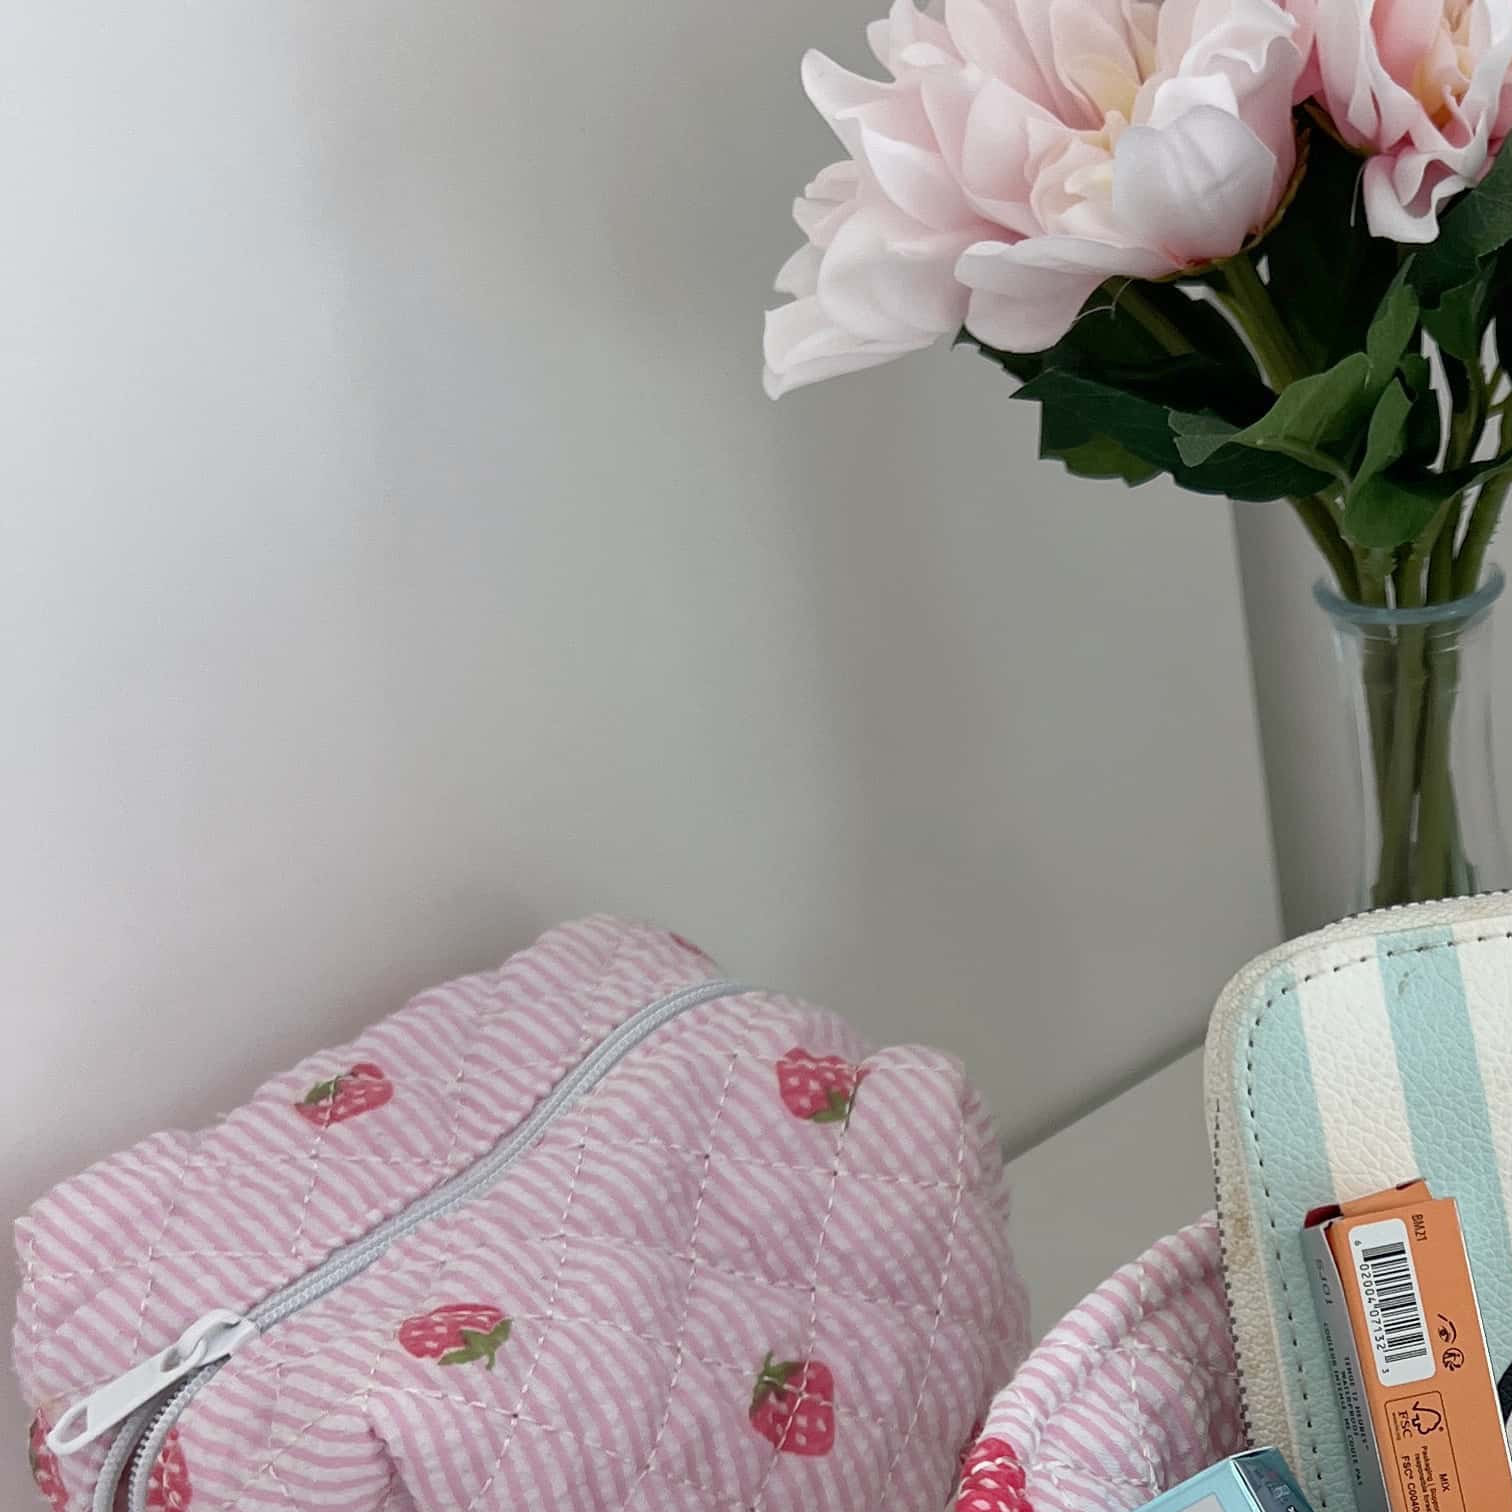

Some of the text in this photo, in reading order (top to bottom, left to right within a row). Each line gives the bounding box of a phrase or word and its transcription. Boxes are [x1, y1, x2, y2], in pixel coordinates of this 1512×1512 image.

[1358, 1262, 1377, 1304] 02004
[1368, 1309, 1387, 1350] 07132
[1438, 1472, 1450, 1492] MIX
